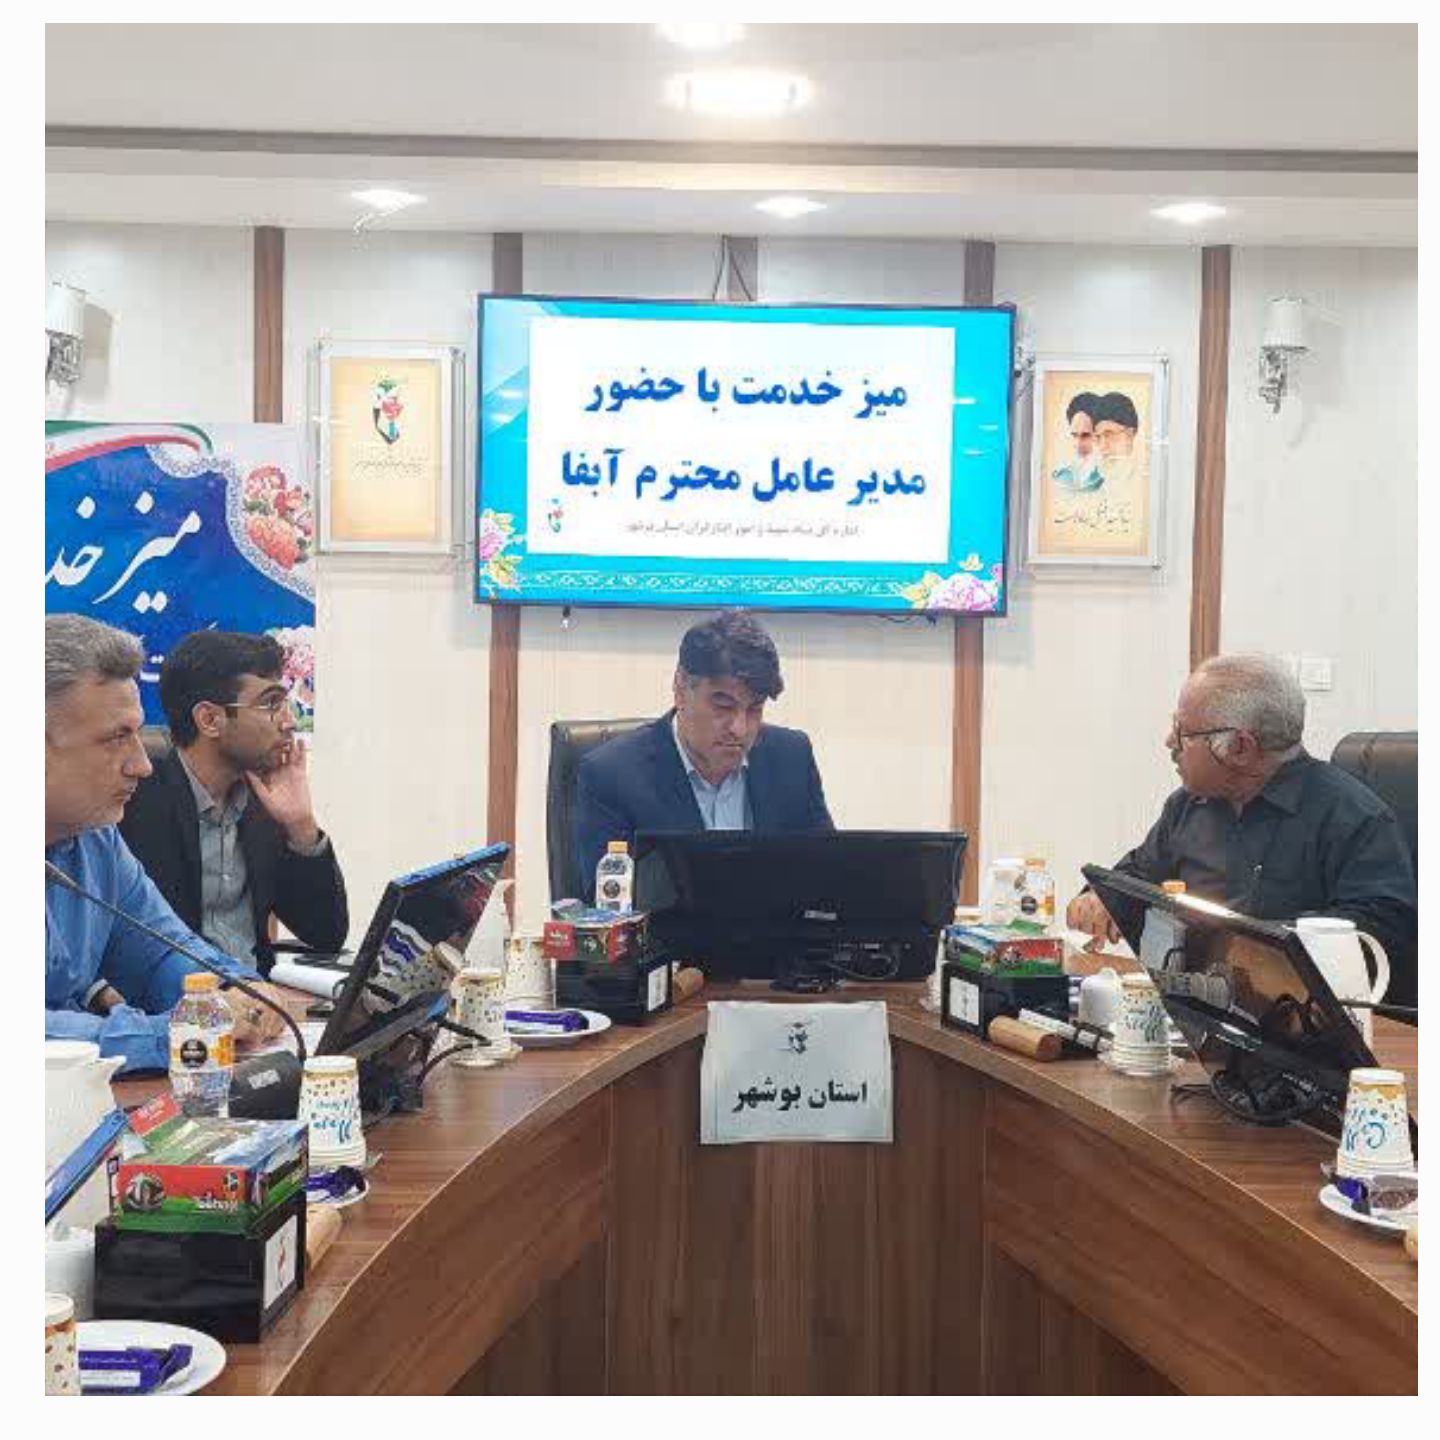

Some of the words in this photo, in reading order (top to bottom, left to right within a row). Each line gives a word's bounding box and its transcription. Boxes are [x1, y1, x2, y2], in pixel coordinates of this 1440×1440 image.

[585, 368, 685, 412] حضور
[698, 368, 720, 411] با
[732, 371, 842, 406] خدمت
[855, 376, 908, 419] میز
[562, 448, 624, 496] آبفا
[636, 460, 741, 501] محترم
[752, 458, 835, 502] عامل
[847, 470, 926, 506] مدیر
[45, 496, 103, 585] خد
[93, 491, 201, 613] میز
[732, 1077, 802, 1113] بوشهر
[808, 1080, 868, 1110] استان
